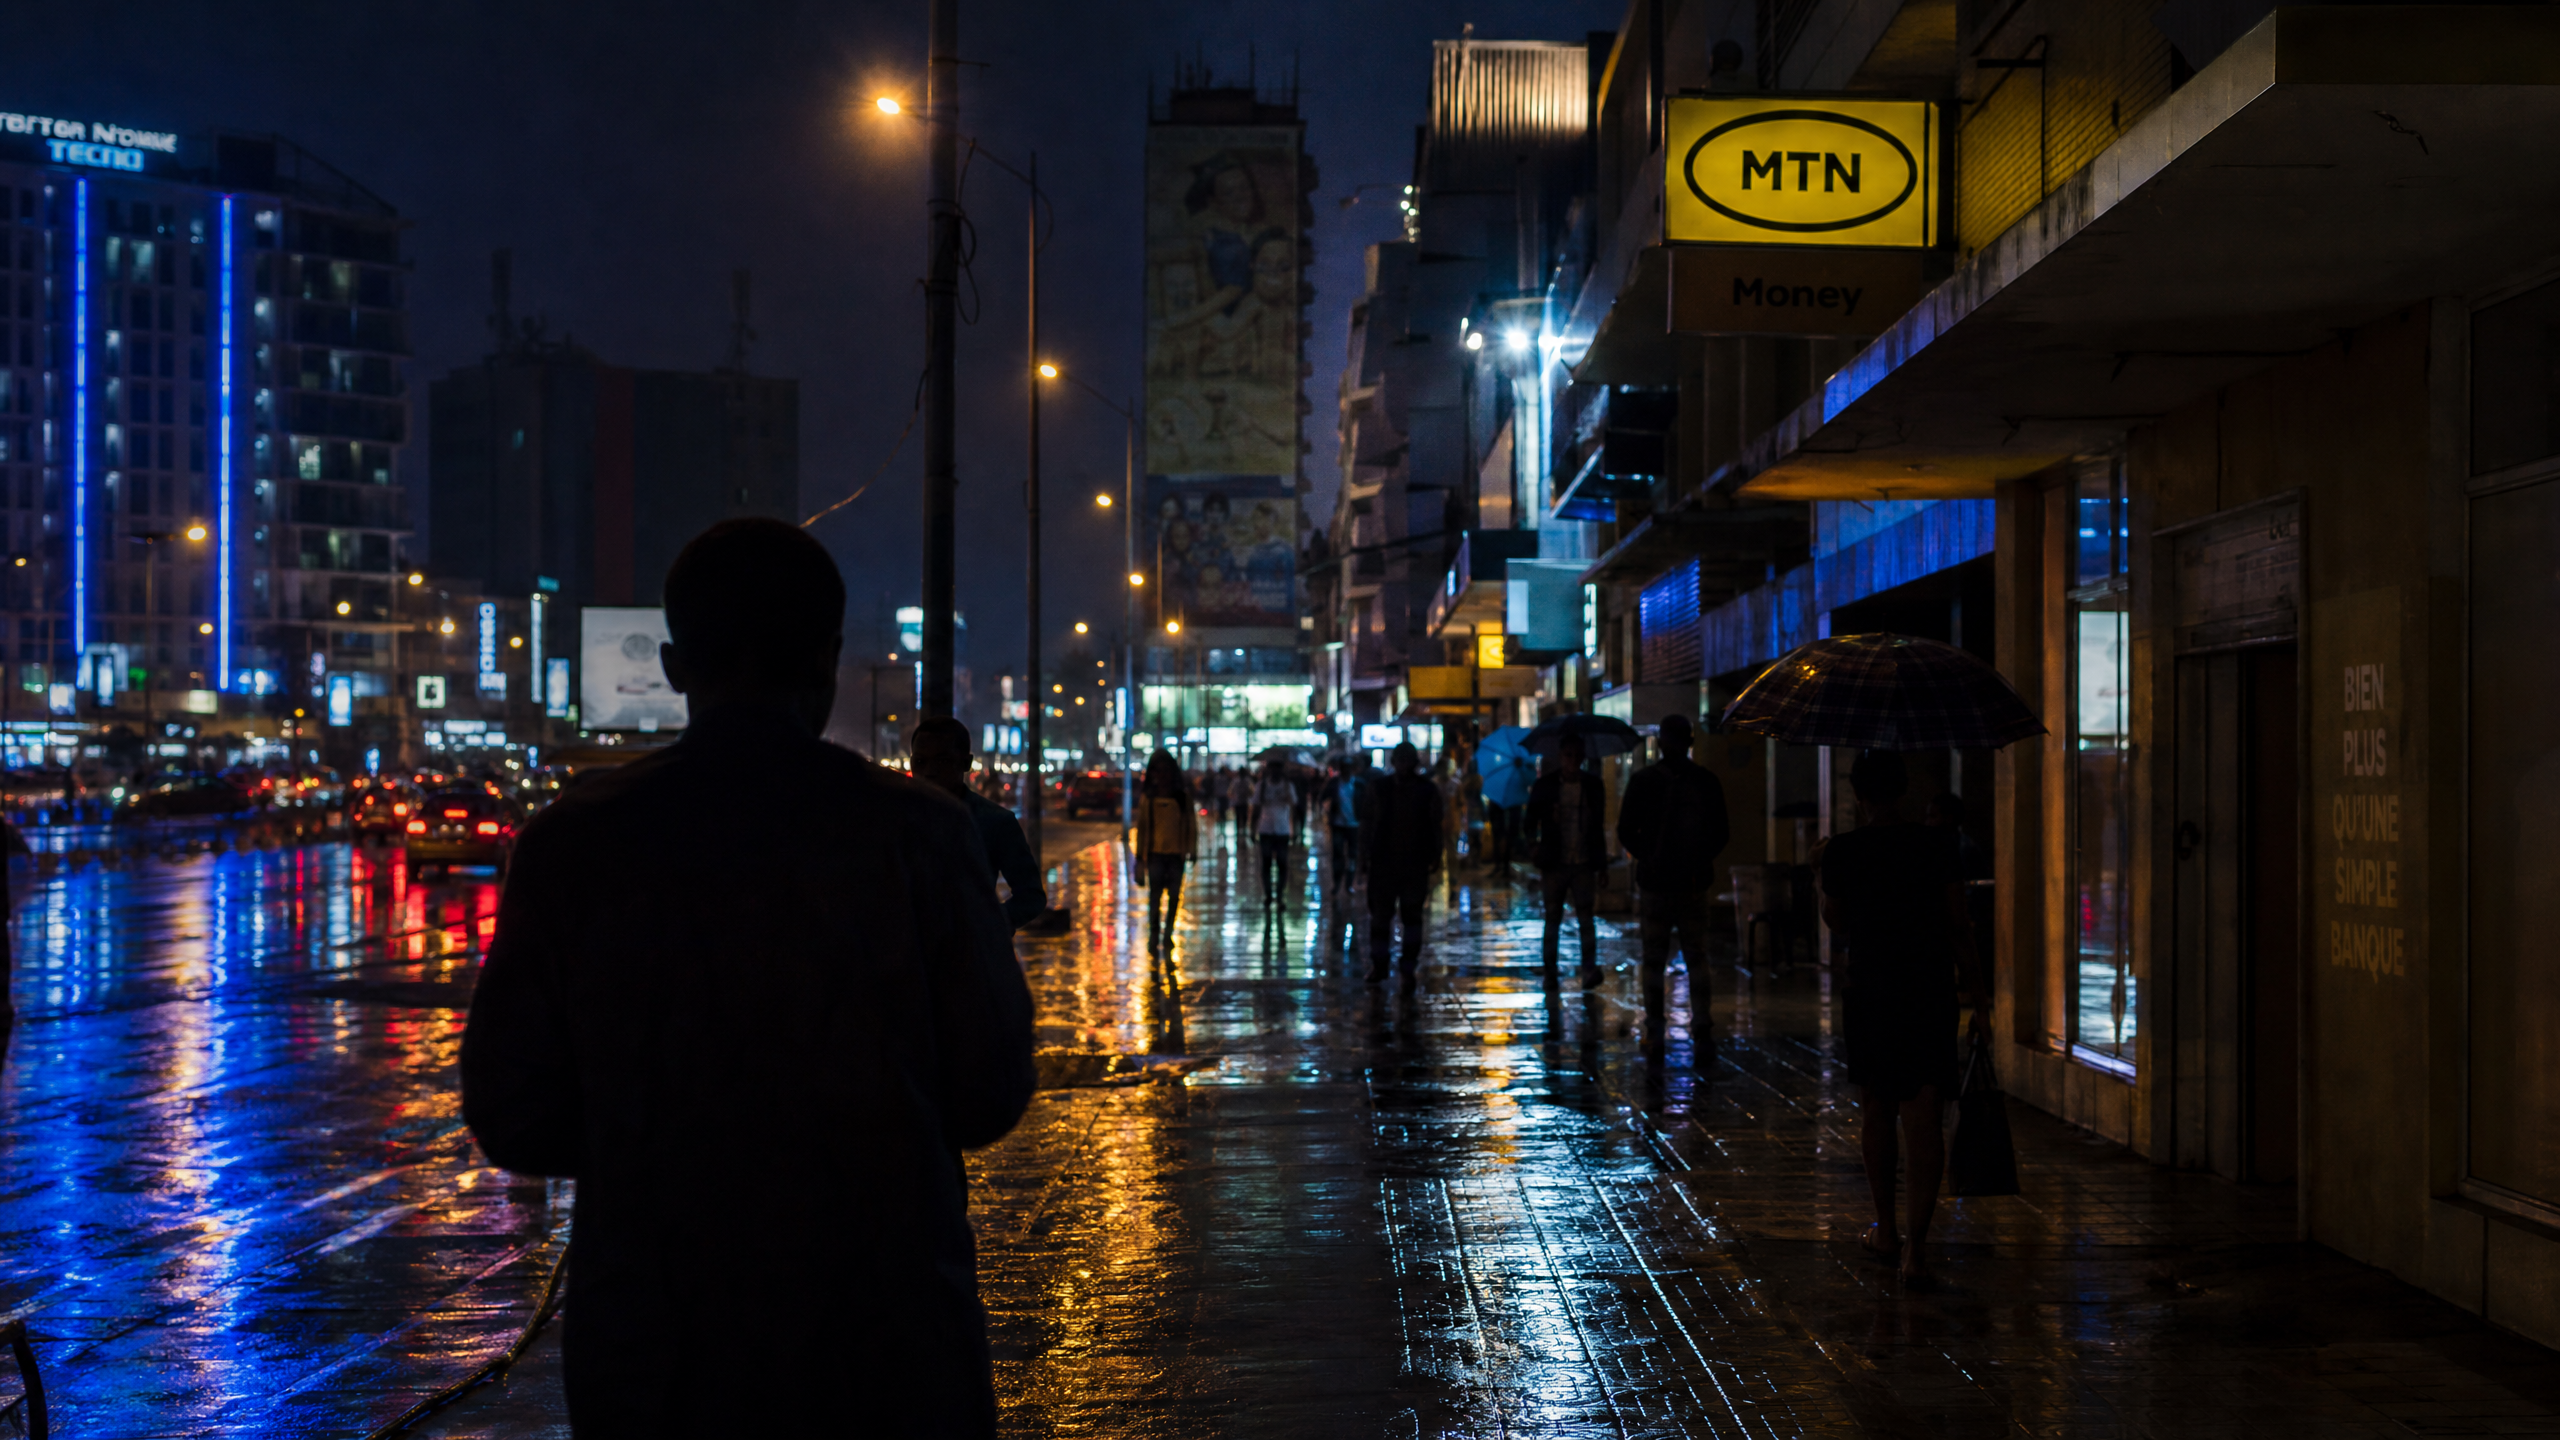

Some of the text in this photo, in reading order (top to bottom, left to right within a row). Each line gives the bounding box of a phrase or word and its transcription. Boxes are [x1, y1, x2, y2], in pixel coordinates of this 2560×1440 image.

[1741, 149, 1861, 193] MTN
[1732, 278, 1863, 315] Money
[2343, 663, 2385, 712] BIEN
[2343, 727, 2387, 777] PLUS
[2335, 856, 2398, 908] SIMPLE
[2330, 920, 2405, 984] BANQUE
